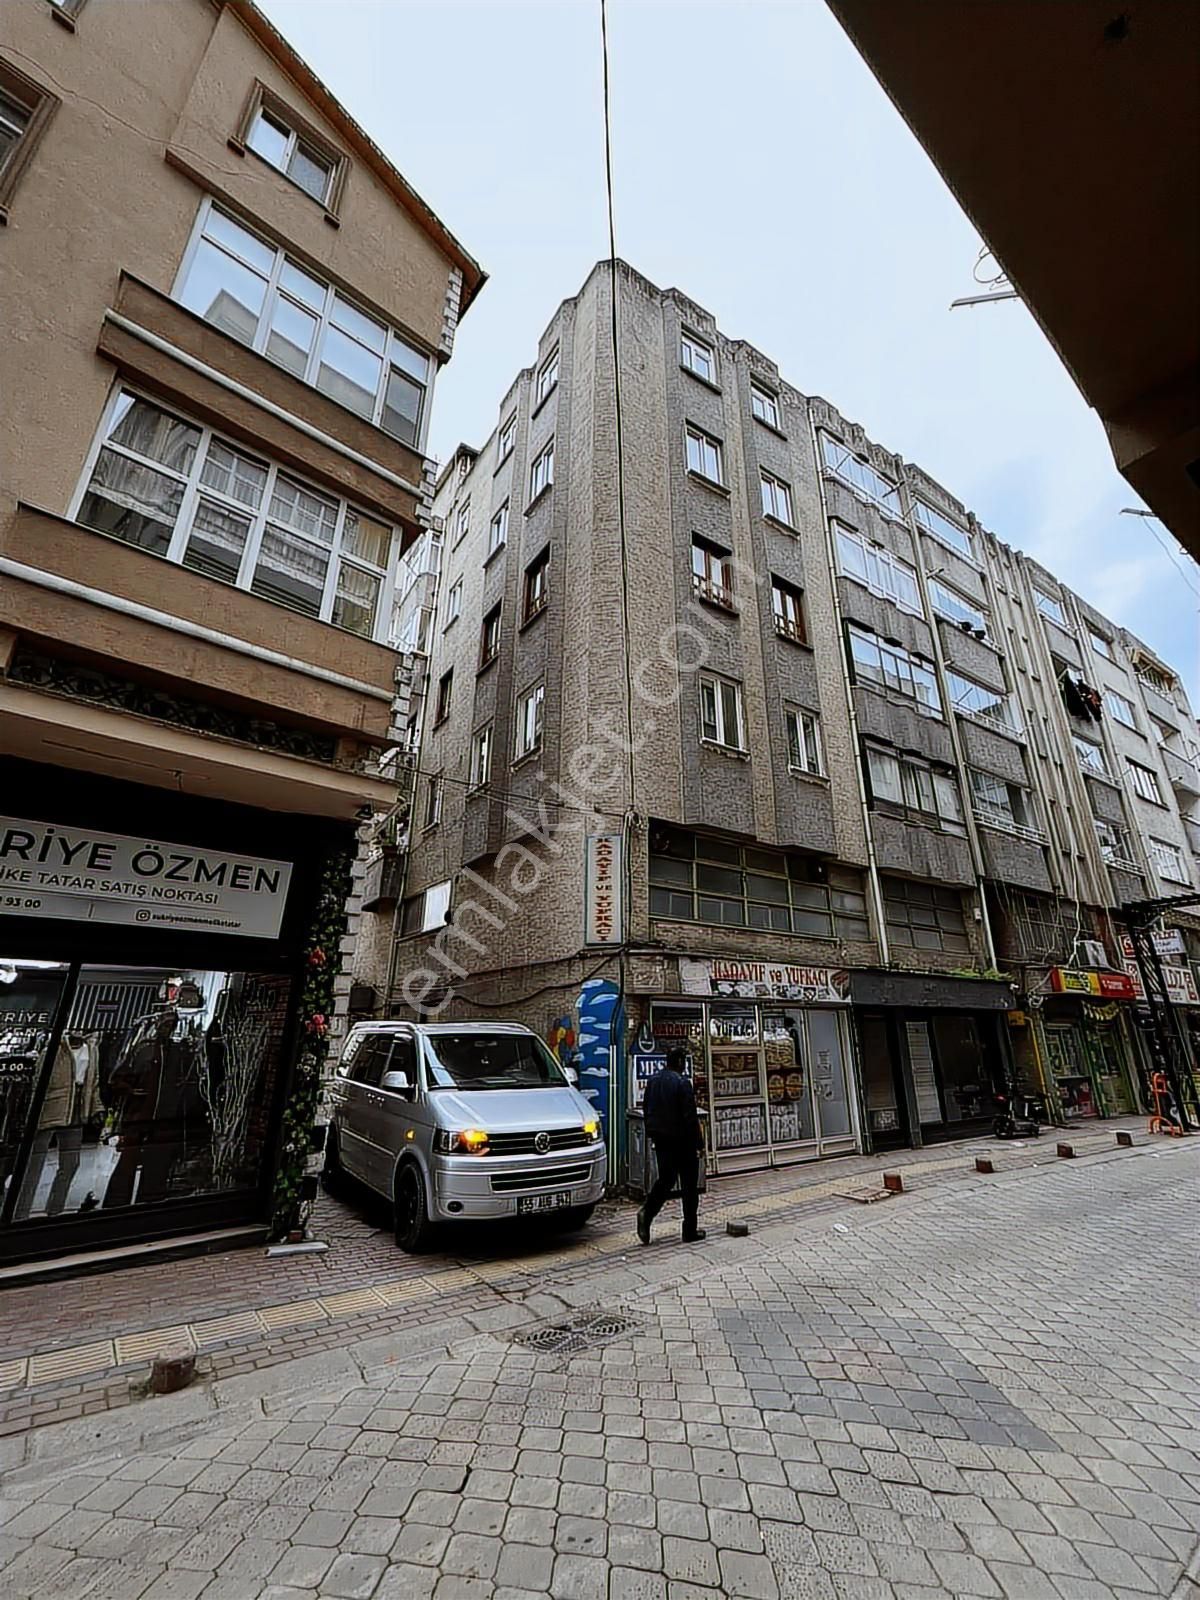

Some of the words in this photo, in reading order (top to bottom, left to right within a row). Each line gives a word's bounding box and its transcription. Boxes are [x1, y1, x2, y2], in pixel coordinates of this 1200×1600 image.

[38, 872, 96, 890] TATAR
[100, 880, 148, 898] SATIŞ
[152, 887, 219, 904] NOKTASI
[131, 844, 281, 893] ÖZMEN
